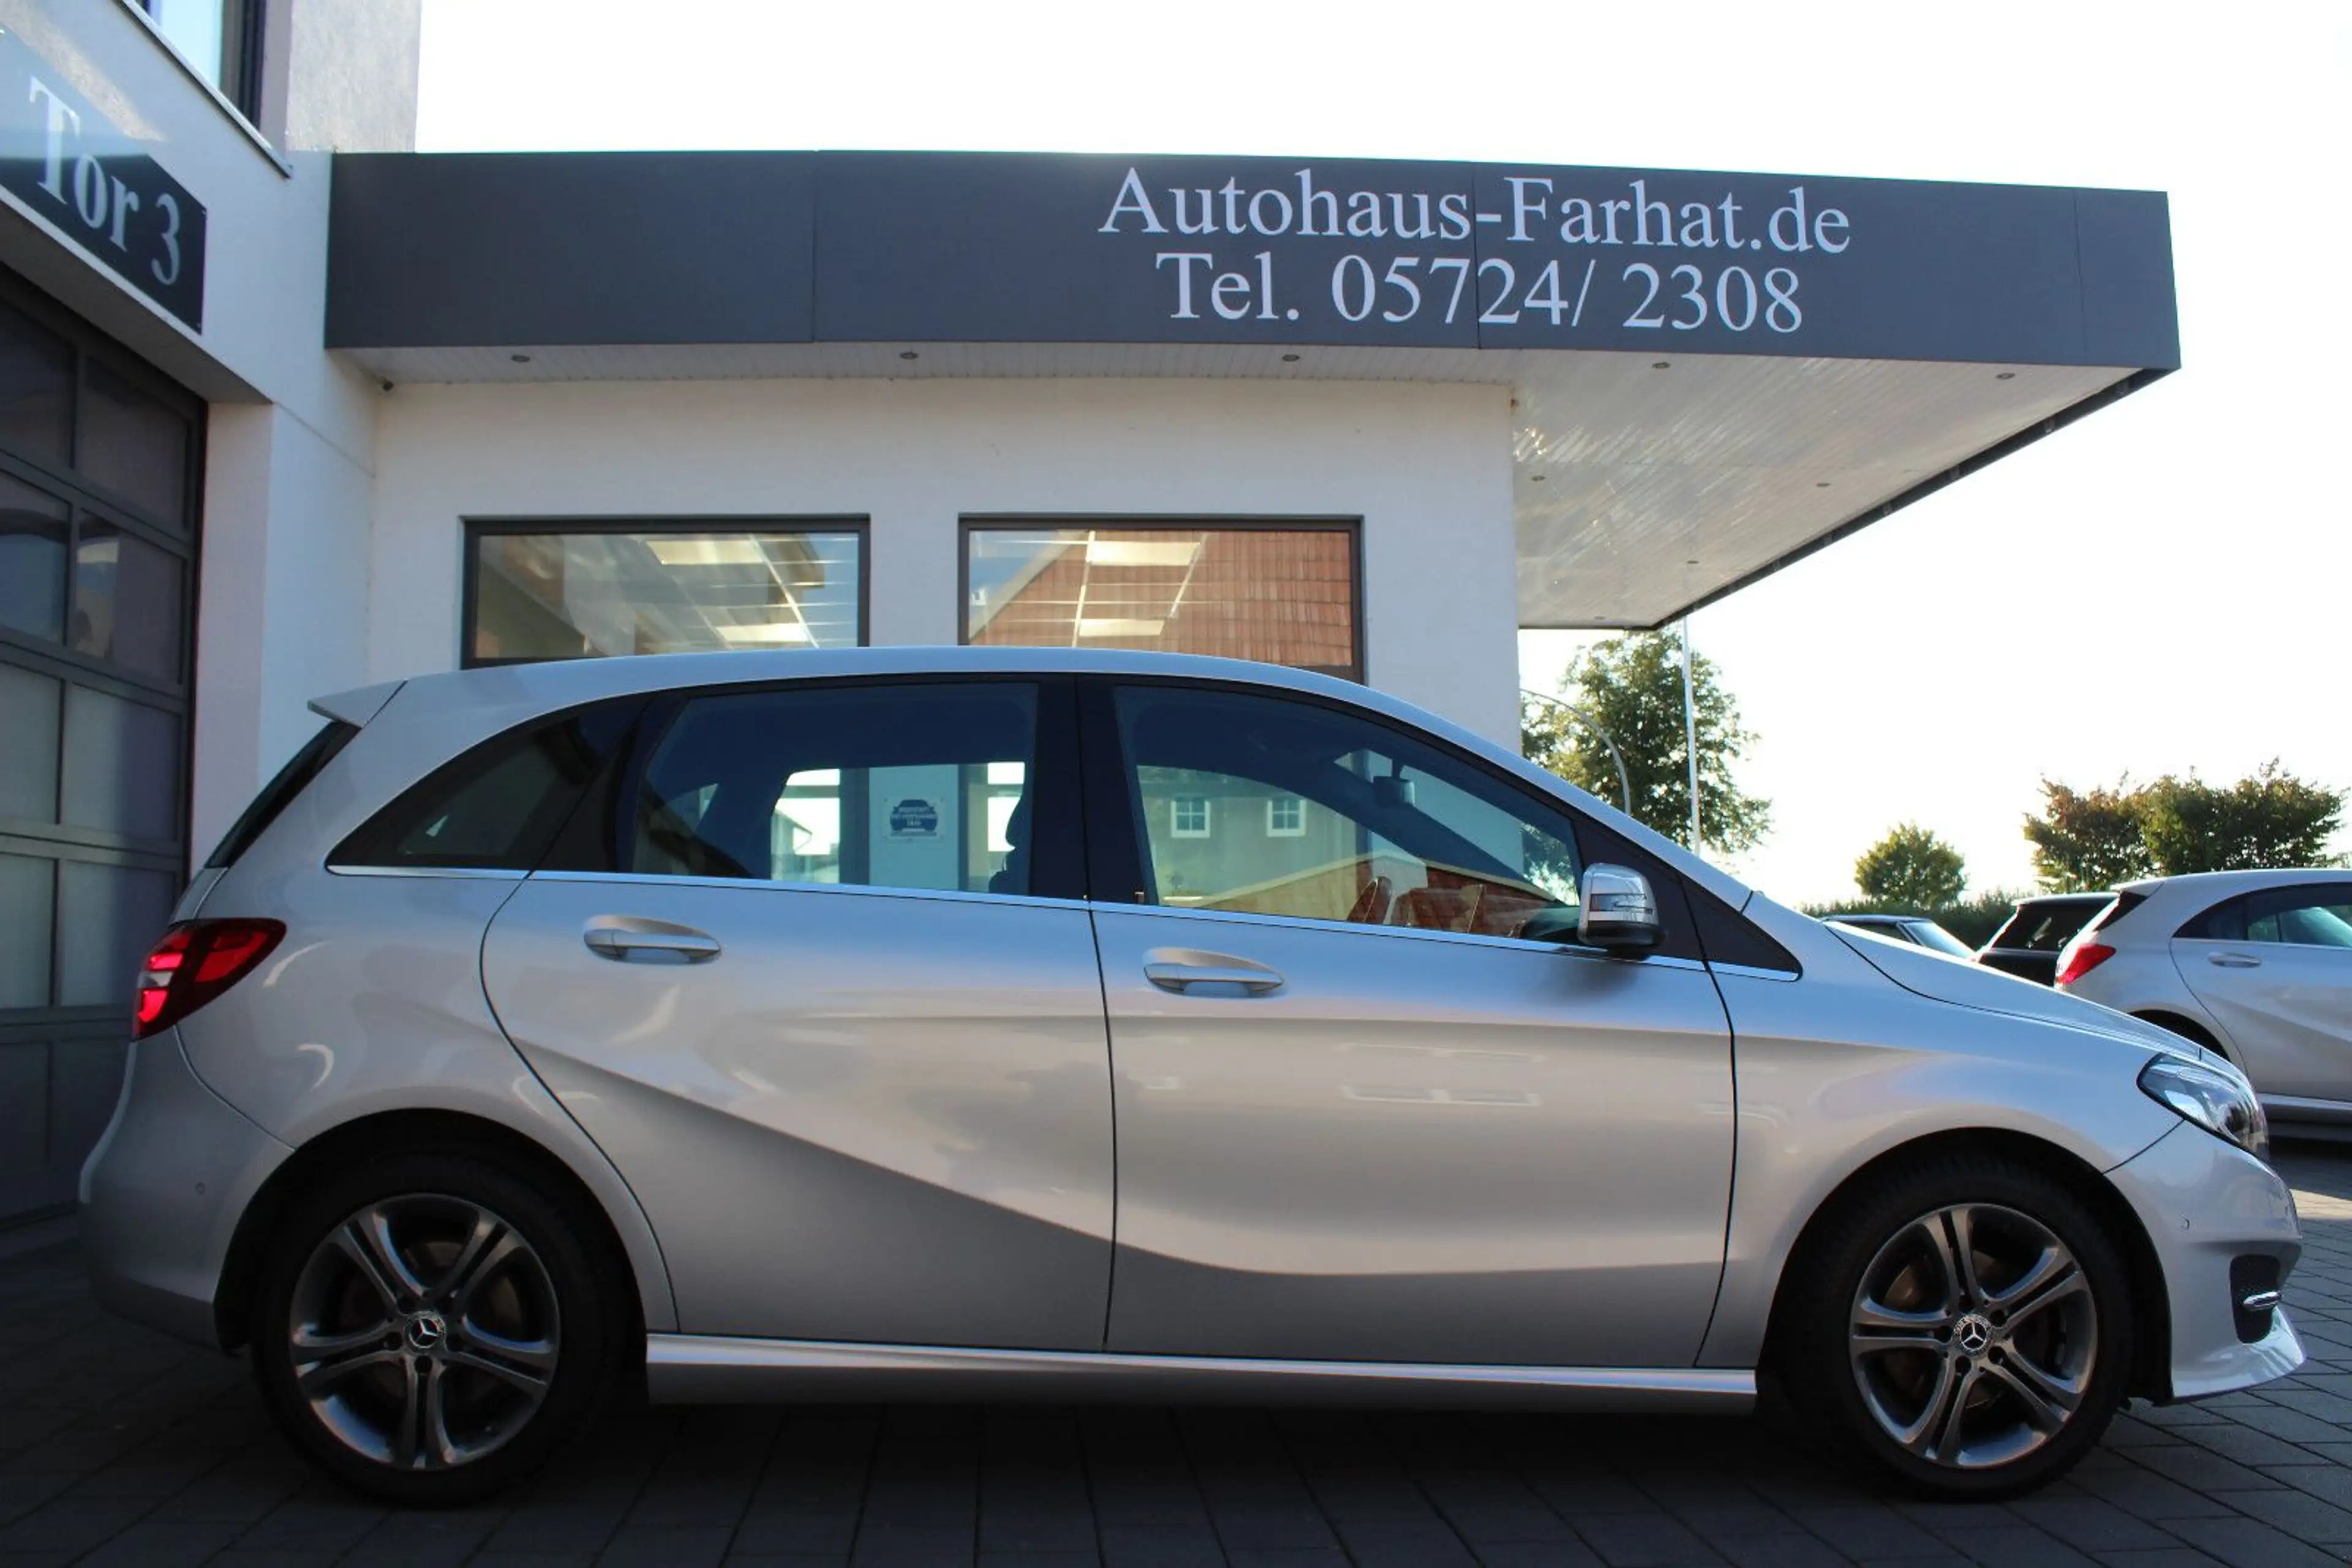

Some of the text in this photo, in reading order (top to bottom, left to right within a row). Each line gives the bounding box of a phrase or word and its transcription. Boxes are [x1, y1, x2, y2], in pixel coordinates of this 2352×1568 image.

[29, 75, 180, 285] Tor 3
[1098, 166, 1850, 254] Autohaus-Farhat.de
[1155, 251, 1803, 333] Tel. 05724/ 2308
